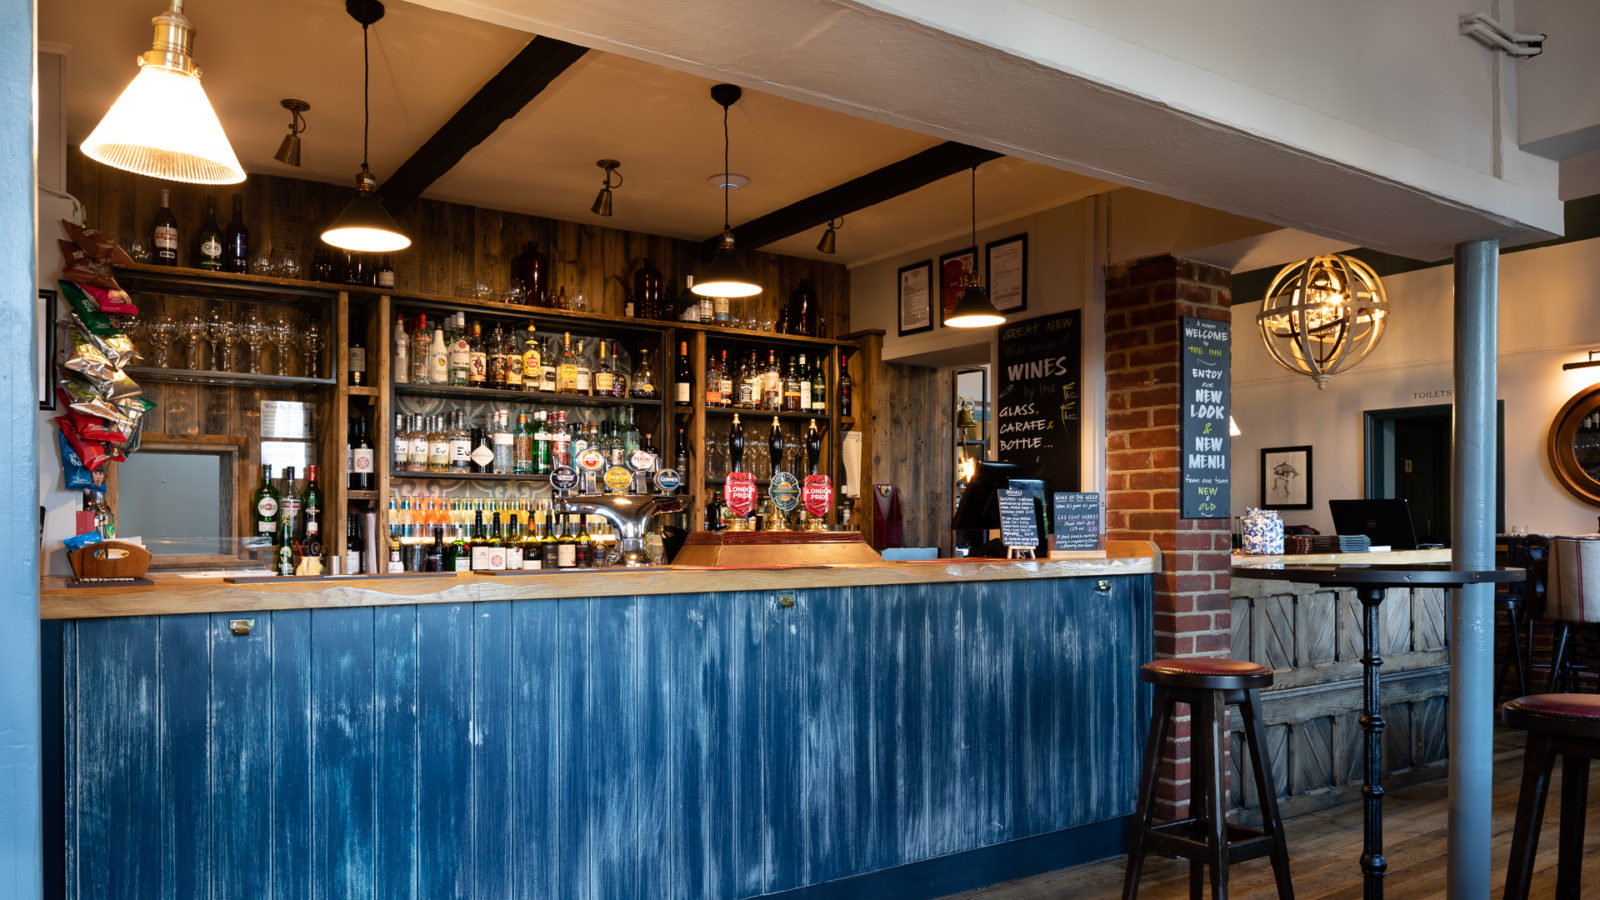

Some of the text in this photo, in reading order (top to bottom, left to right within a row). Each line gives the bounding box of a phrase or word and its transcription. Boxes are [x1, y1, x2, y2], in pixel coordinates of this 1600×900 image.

[1002, 317, 1073, 340] GREAT NEW
[1185, 327, 1229, 341] WELCOME
[1209, 348, 1222, 357] INN
[1008, 356, 1067, 381] WINES
[1192, 368, 1222, 379] ENJOY
[1196, 389, 1222, 403] NEW
[1413, 390, 1452, 399] TOILETS
[1190, 404, 1225, 420] LOOK
[1000, 419, 1046, 434] CARAFE
[1203, 422, 1212, 435] &
[1195, 437, 1223, 452] NEW
[1188, 454, 1225, 470] MENU
[1198, 487, 1218, 496] NEW
[1199, 503, 1216, 511] OLD
